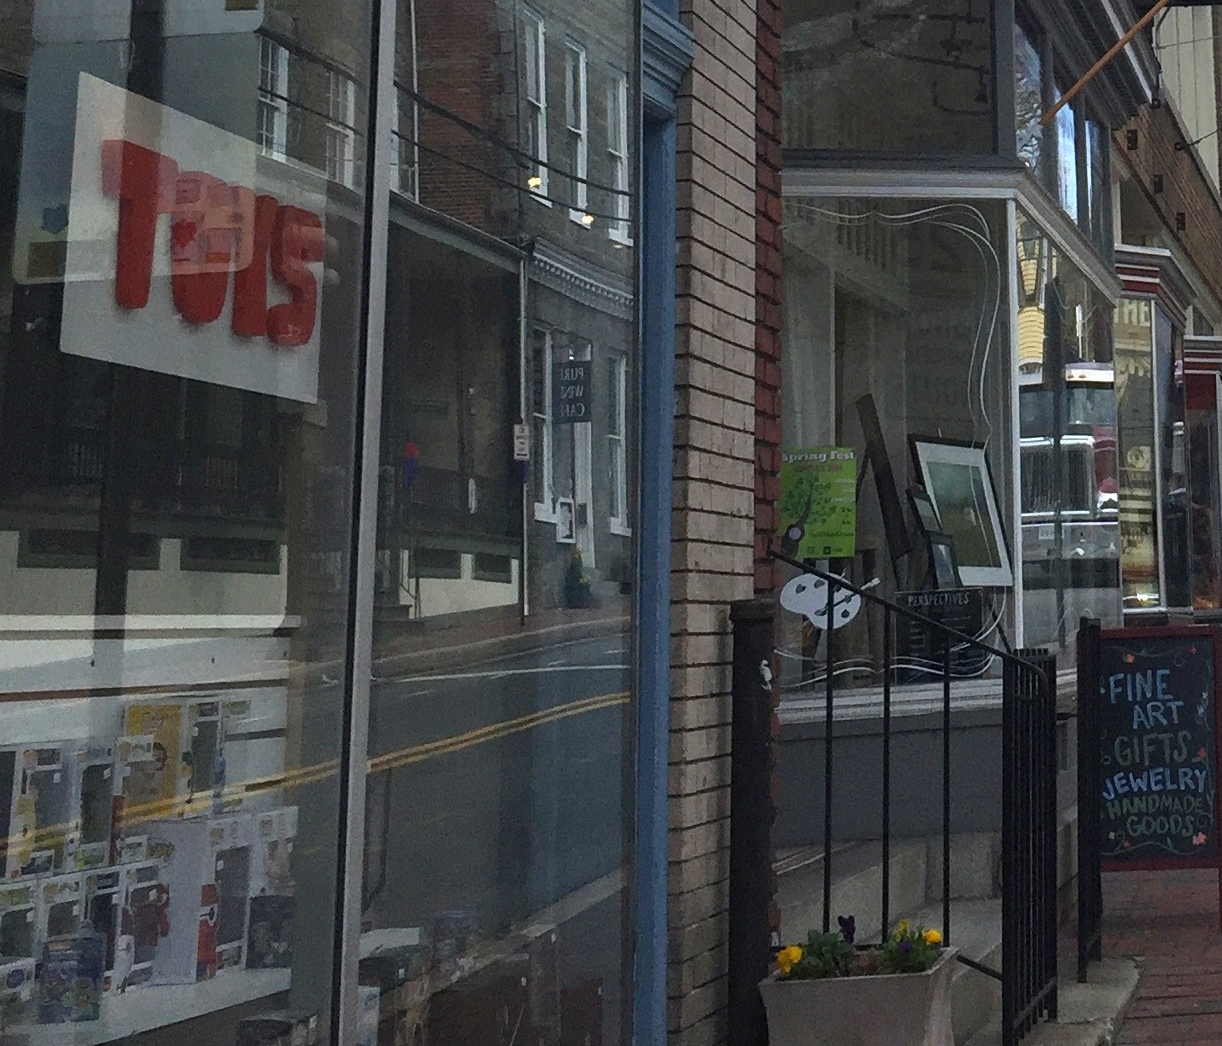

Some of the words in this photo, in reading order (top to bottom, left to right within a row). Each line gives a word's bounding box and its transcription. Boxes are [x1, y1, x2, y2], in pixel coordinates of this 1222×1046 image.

[1109, 668, 1174, 704] FINE
[1132, 700, 1185, 730] ART
[1114, 730, 1192, 766] GIFTS
[1102, 767, 1207, 801] JEWELRY
[1106, 794, 1204, 820] HANDMADE
[1126, 814, 1195, 837] GOODS
